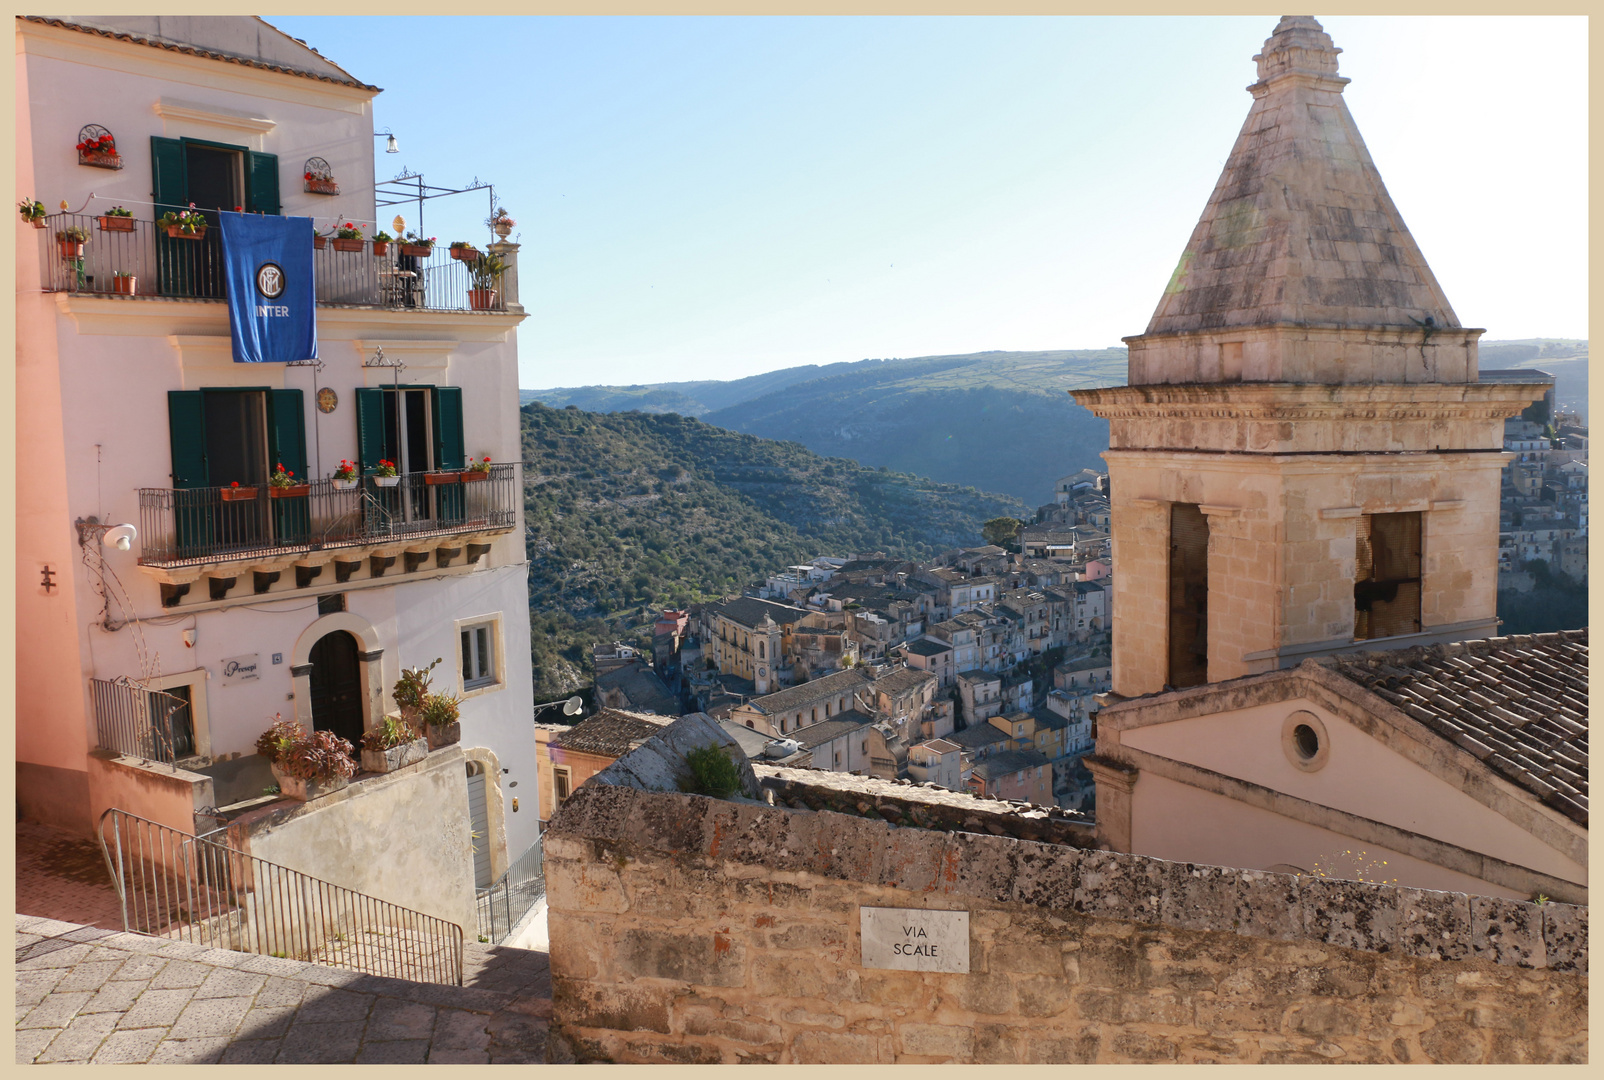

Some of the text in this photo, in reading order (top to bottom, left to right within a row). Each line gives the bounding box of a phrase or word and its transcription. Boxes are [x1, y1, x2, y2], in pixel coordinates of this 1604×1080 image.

[255, 305, 289, 317] INTER
[227, 661, 257, 677] Presepi
[903, 926, 927, 938] VIA
[894, 943, 938, 957] SCALE
